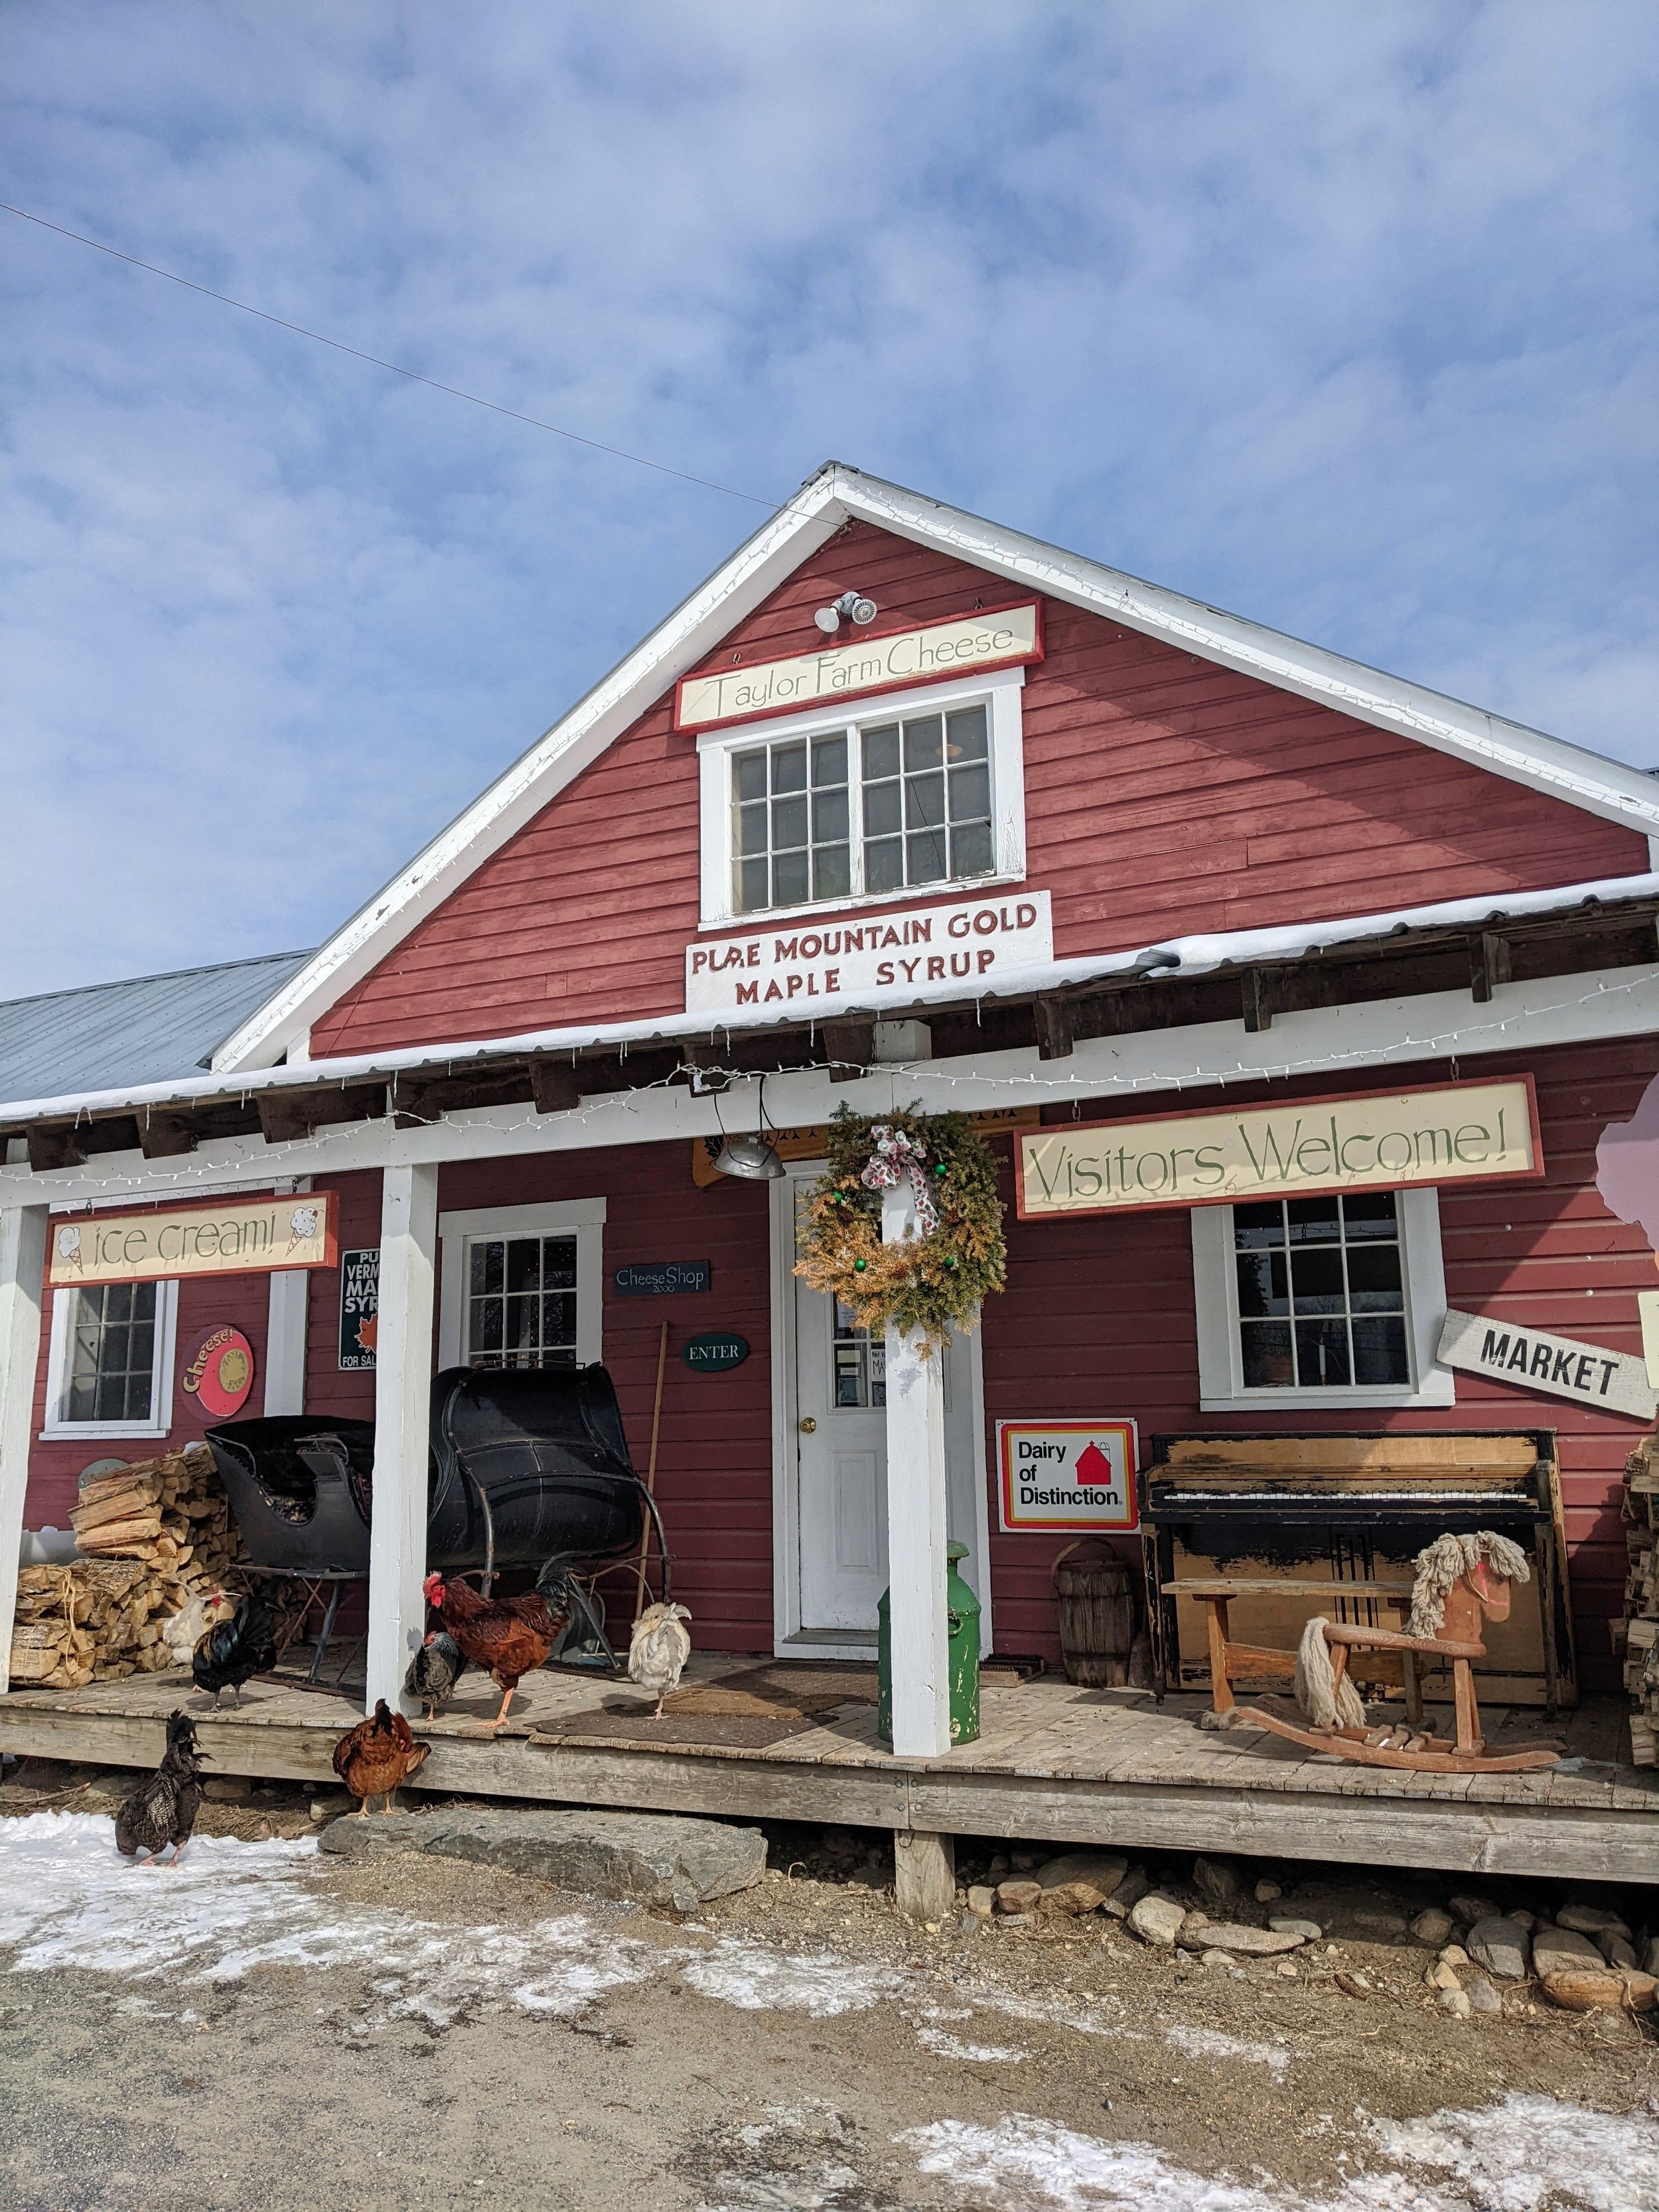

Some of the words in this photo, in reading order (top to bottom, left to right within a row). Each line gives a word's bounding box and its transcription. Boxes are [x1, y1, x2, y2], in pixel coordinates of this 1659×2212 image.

[705, 669, 807, 717] Taylor
[816, 654, 881, 694] Farm
[887, 627, 1013, 676] Cheese
[692, 942, 760, 974] PURE
[774, 919, 932, 962] MOUNTAIN
[948, 904, 1037, 938] GOLD
[735, 968, 841, 1005] MAPLE
[876, 949, 995, 986] SYRUP
[1029, 1143, 1226, 1201] Visitors
[1238, 1107, 1506, 1181] Welcome!
[94, 1227, 147, 1267] ice
[157, 1213, 276, 1260] cream!
[360, 1252, 380, 1264] PU
[346, 1279, 379, 1297] MA
[616, 1268, 665, 1286] Cheese
[666, 1267, 704, 1290] Shop
[183, 1328, 234, 1392] Cheese!
[342, 1356, 359, 1367] FOR
[689, 1345, 739, 1360] ENTER
[1480, 1329, 1619, 1395] MARKET
[1019, 1441, 1066, 1463] Dairy
[1019, 1464, 1037, 1481] of
[1021, 1487, 1118, 1505] Distinction
